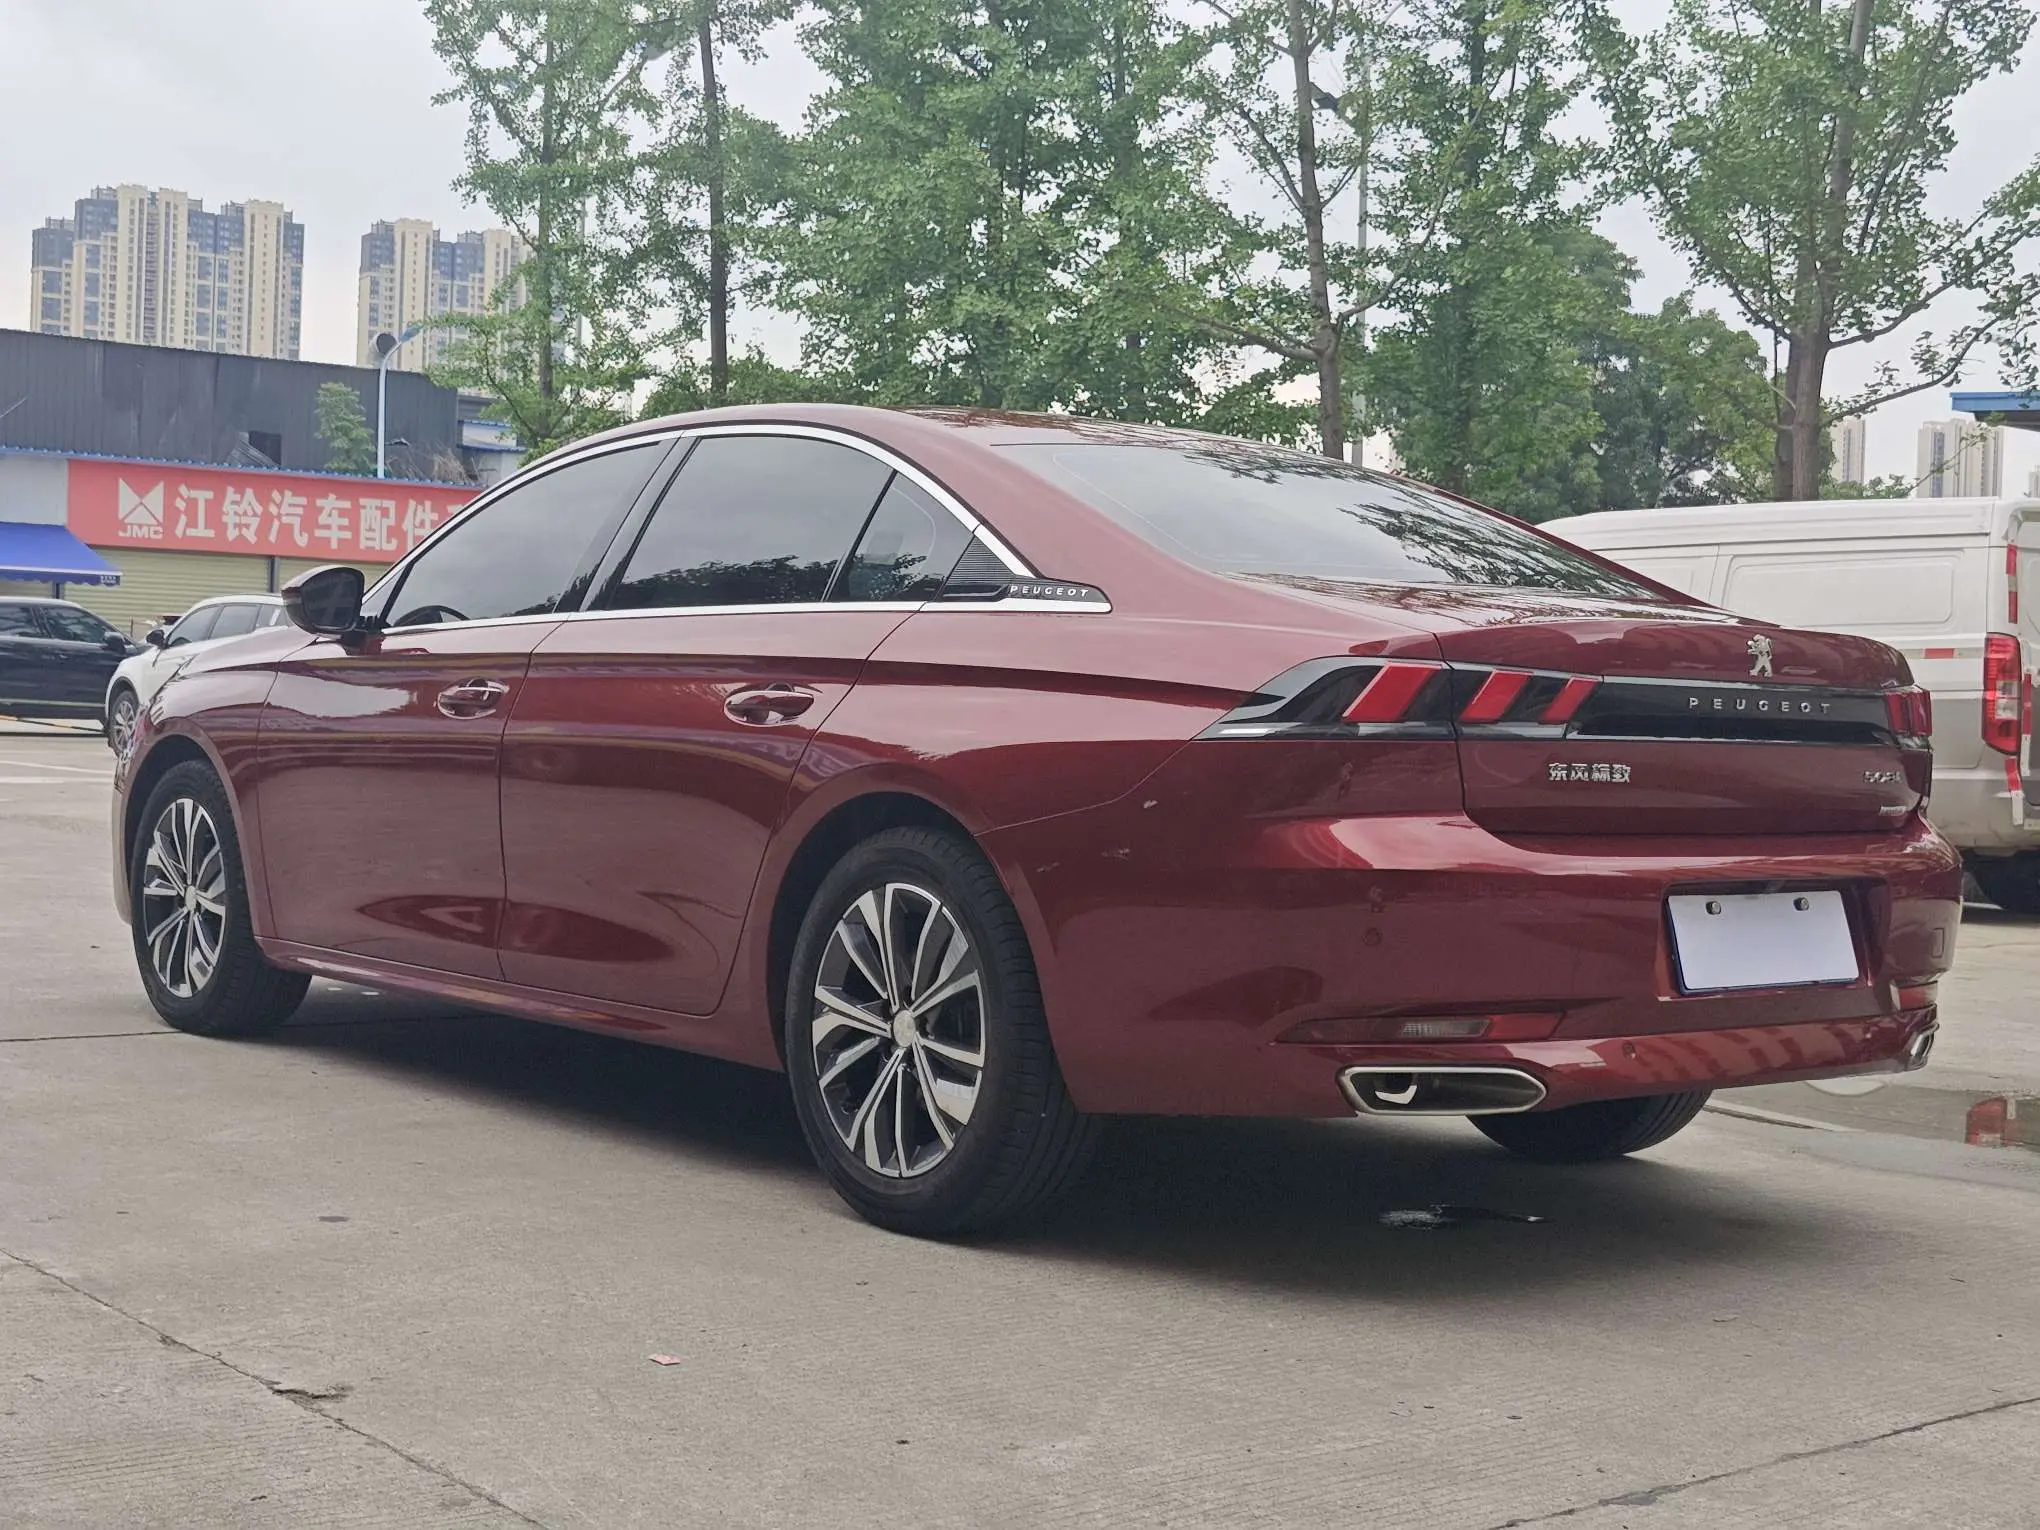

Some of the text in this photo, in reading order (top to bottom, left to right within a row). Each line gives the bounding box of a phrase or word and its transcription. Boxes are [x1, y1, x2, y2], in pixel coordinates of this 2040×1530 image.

[175, 484, 464, 552] 江铃汽车配件
[117, 524, 165, 541] JMC
[1009, 585, 1089, 598] PEUGEOT
[1688, 697, 1831, 714] PEUGEOT
[1548, 762, 1632, 783] 东风标致
